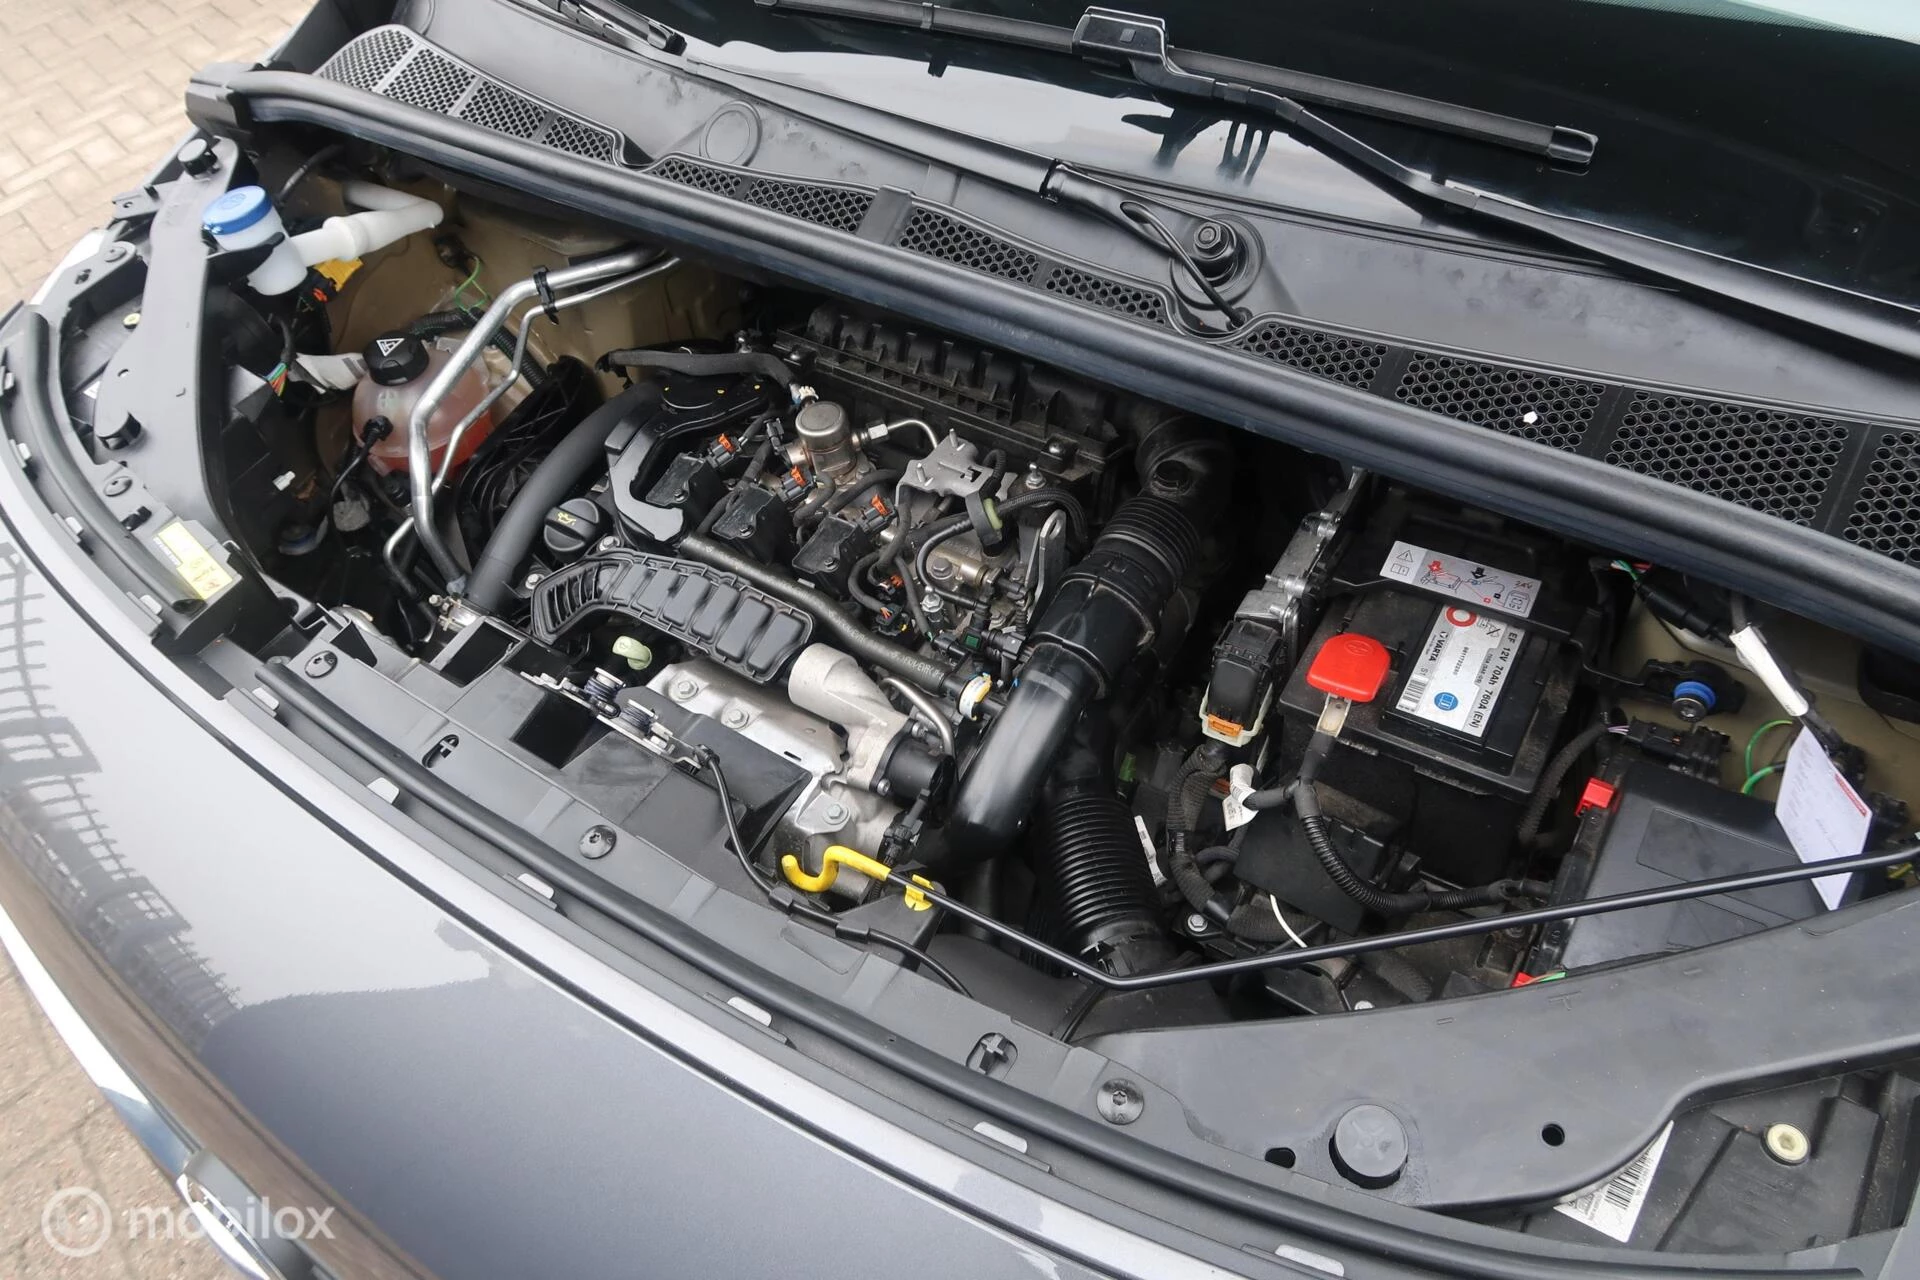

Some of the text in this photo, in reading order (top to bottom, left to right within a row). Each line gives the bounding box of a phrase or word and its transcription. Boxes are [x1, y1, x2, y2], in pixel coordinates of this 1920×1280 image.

[1428, 637, 1444, 662] VARTA
[1498, 646, 1510, 661] 12V
[1488, 665, 1503, 685] 70Ah
[1478, 689, 1493, 710] 760A
[1468, 710, 1484, 728] (EN)
